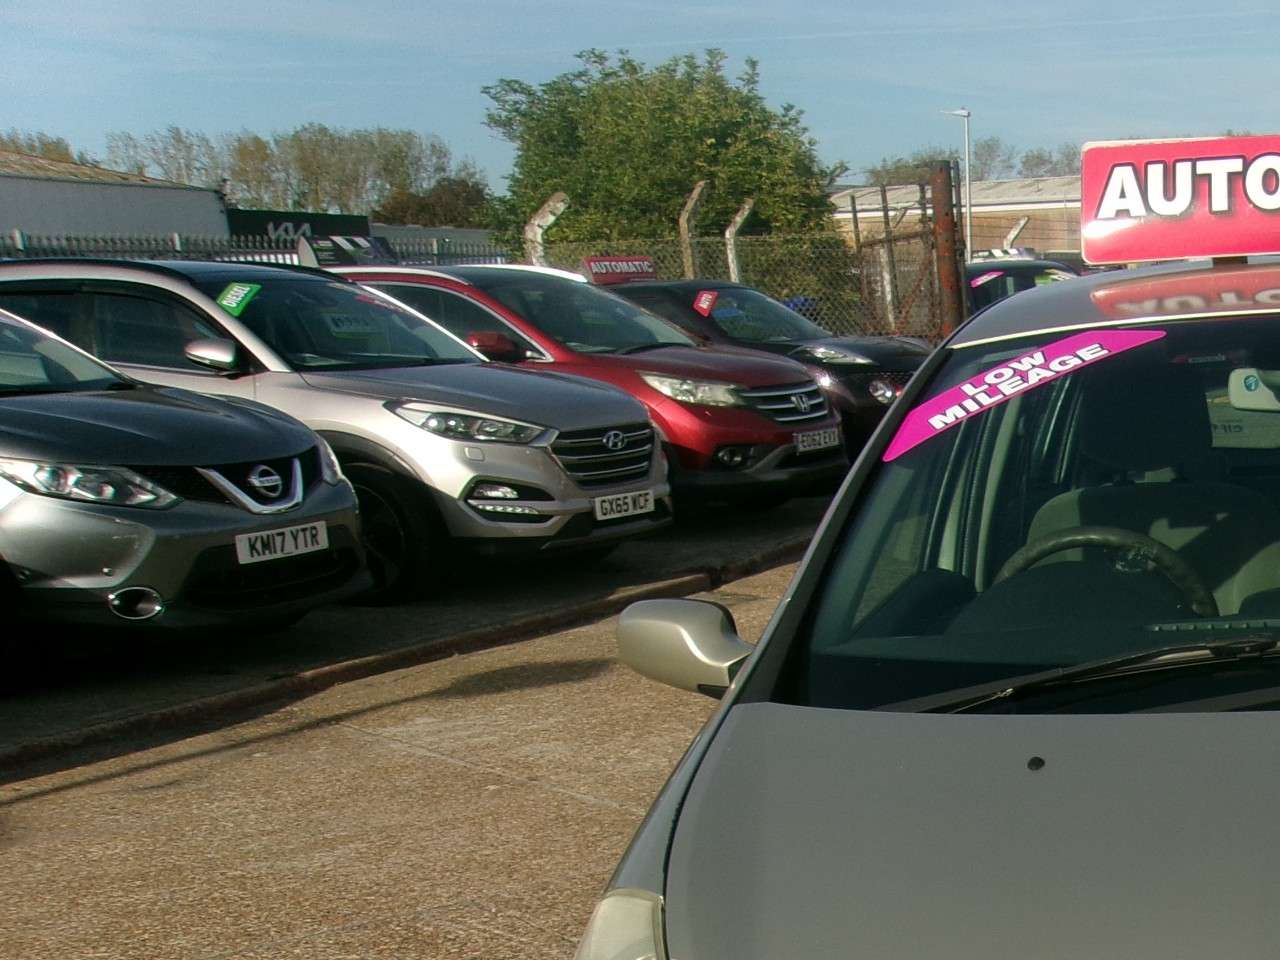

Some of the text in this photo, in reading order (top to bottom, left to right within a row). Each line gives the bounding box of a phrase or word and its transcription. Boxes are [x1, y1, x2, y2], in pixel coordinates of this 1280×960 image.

[590, 261, 654, 274] AUTOMATIC
[928, 343, 1111, 430] MILEAGE
[961, 351, 1046, 397] LOW
[600, 496, 629, 516] GX65
[248, 525, 321, 558] KM17 YTR
